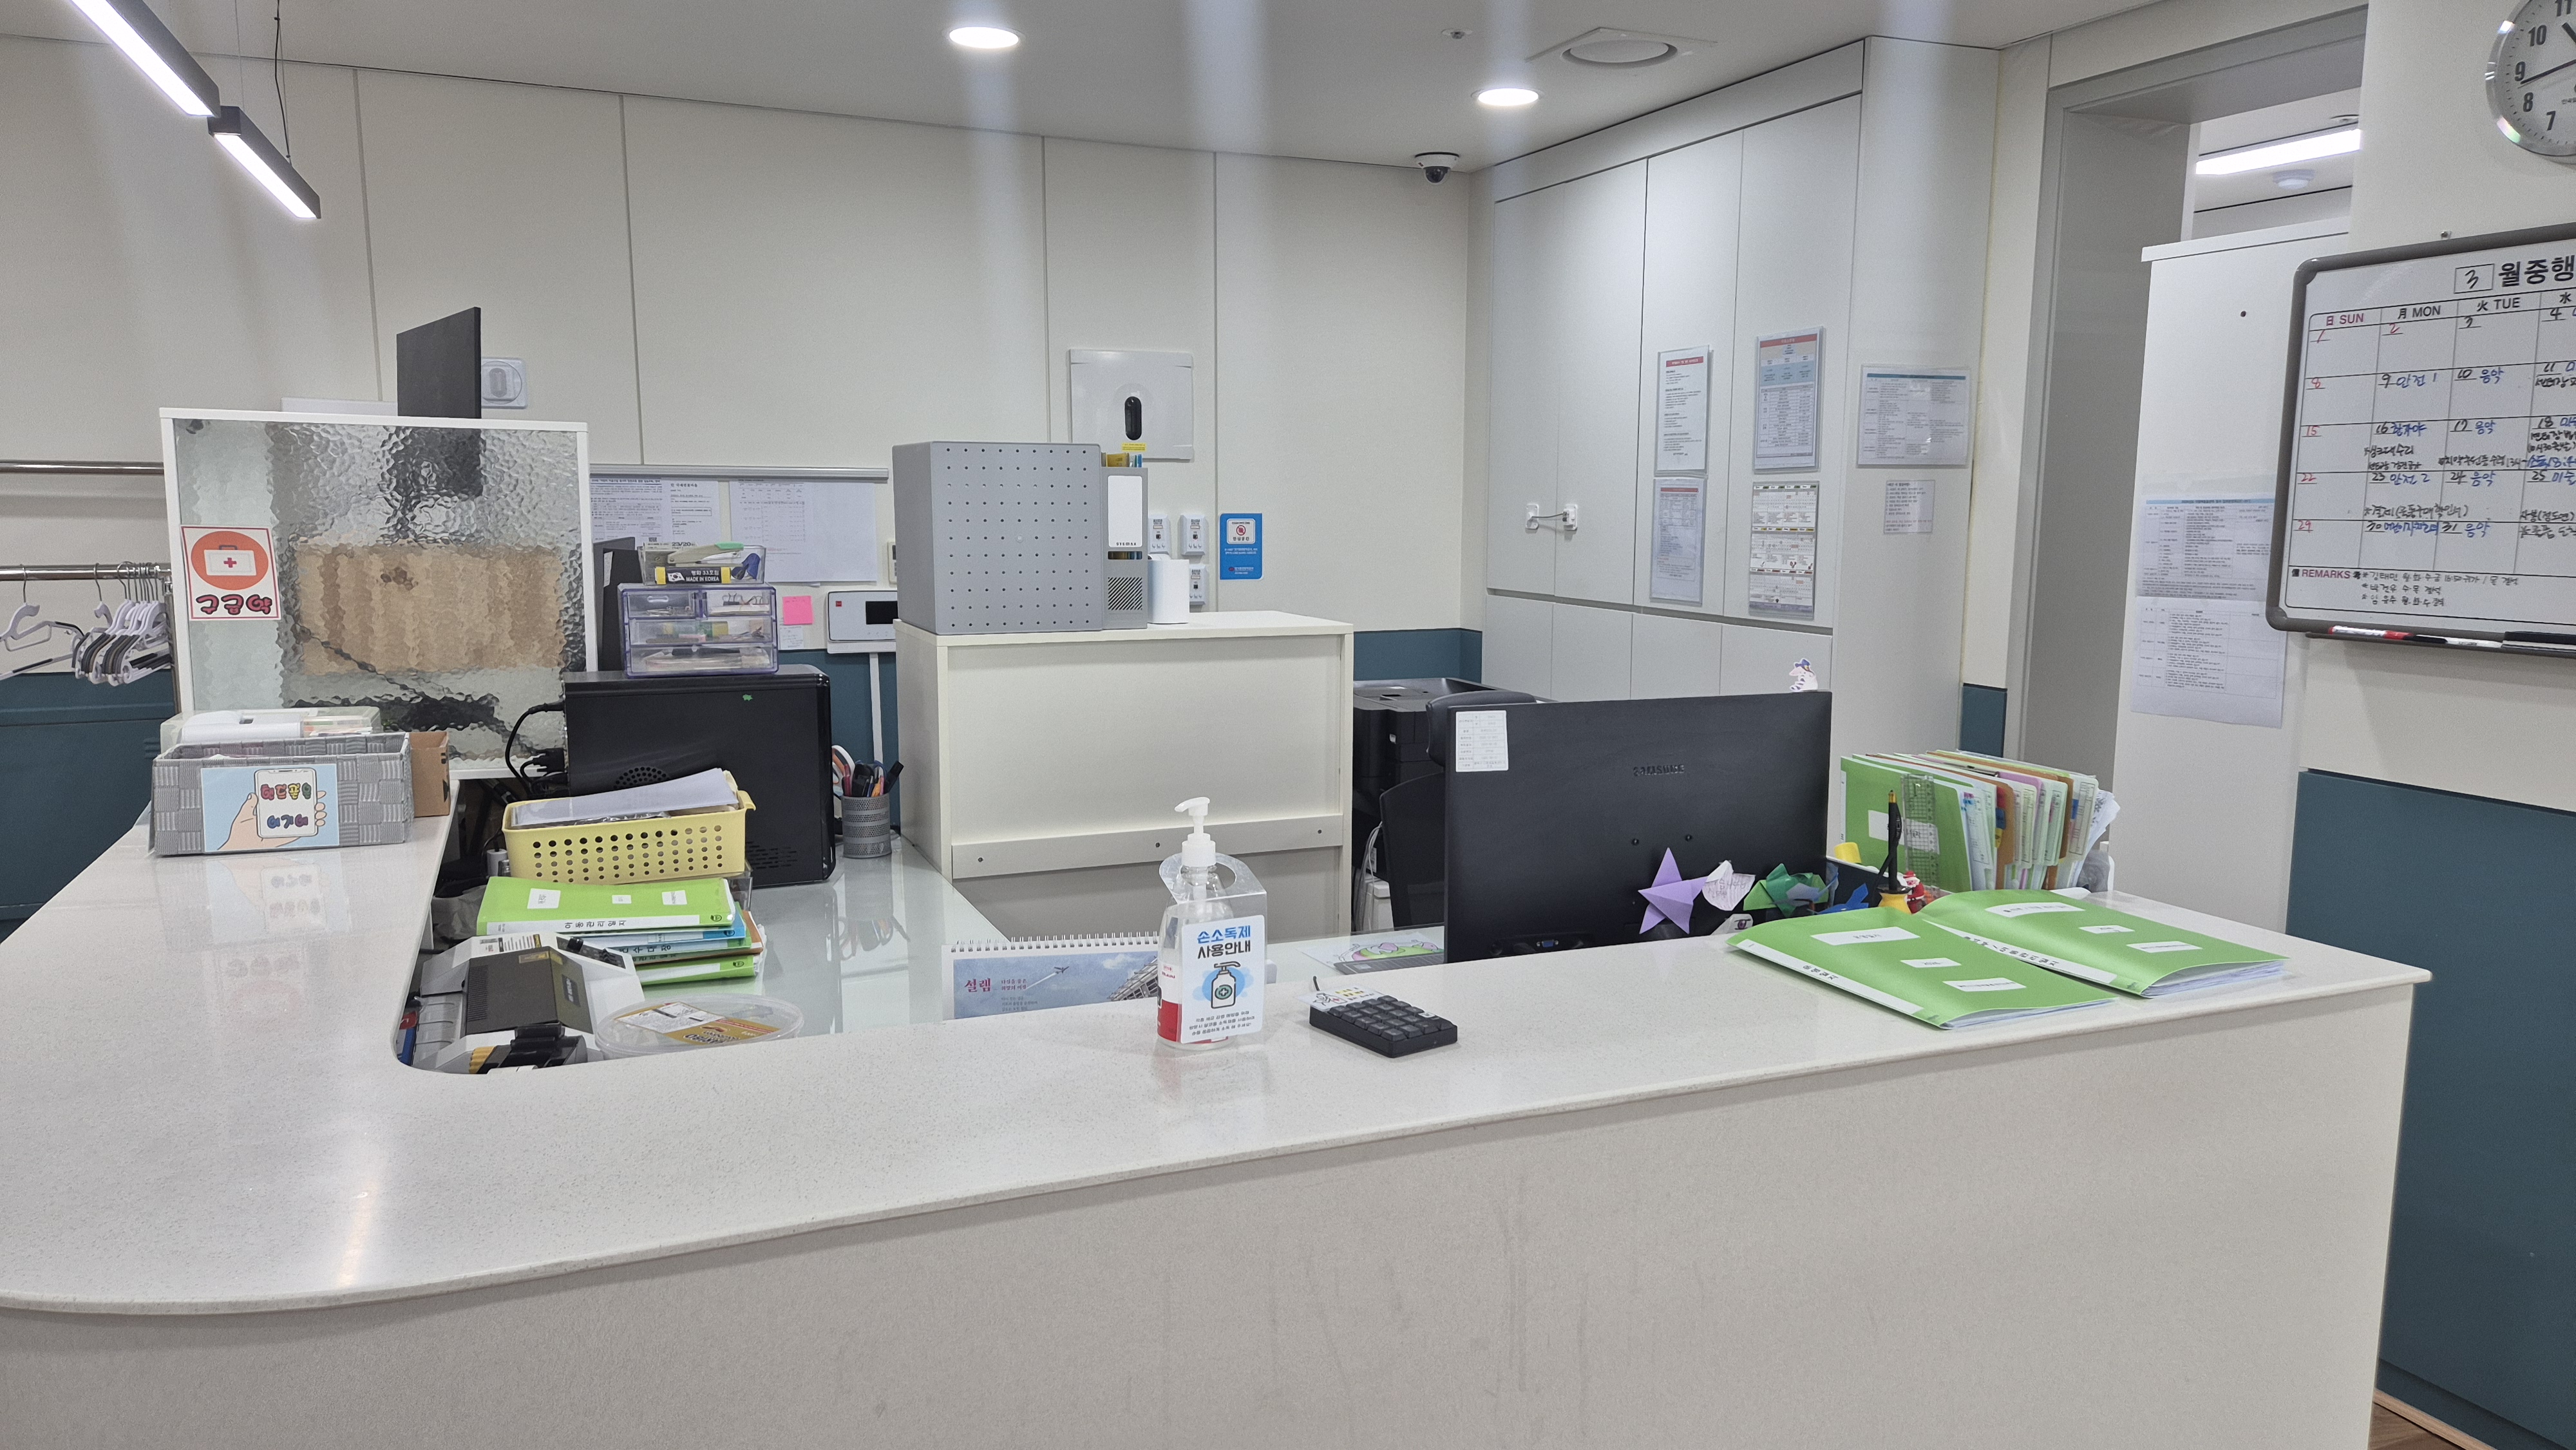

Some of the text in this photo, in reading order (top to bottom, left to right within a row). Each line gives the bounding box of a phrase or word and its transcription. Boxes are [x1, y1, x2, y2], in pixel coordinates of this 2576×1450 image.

[2528, 24, 2547, 46] 10
[2514, 61, 2526, 82] 9
[2523, 92, 2533, 112] 8
[2546, 111, 2556, 131] 7
[2465, 255, 2575, 289] 3 월중행
[2477, 297, 2521, 312] 火 TUE
[2559, 292, 2571, 304] 水
[2326, 313, 2364, 326] 日 SUN
[2397, 306, 2441, 319] 月 MON
[2550, 307, 2562, 321] 4
[2389, 323, 2400, 334] 2
[2382, 374, 2391, 388] 9
[2458, 367, 2505, 384] 10 음악
[2311, 377, 2321, 389] 8
[2376, 421, 2388, 434] 16
[2454, 419, 2496, 435] 17 음악
[2538, 417, 2553, 428] 18
[2306, 425, 2320, 436] 15
[2301, 473, 2316, 482] 22
[2372, 473, 2385, 482] 23
[2421, 474, 2430, 482] 2
[2450, 471, 2496, 487] 24 음악
[2532, 471, 2546, 480] 25
[2298, 520, 2311, 532] 29
[2442, 521, 2490, 538] 31 음악
[2302, 569, 2351, 579] REMARKS
[196, 594, 272, 615] 구급약
[267, 814, 308, 829] 여기에
[1198, 925, 1251, 945] 손소독제
[1198, 940, 1251, 959] 사용안내
[964, 977, 992, 993] 설렘
